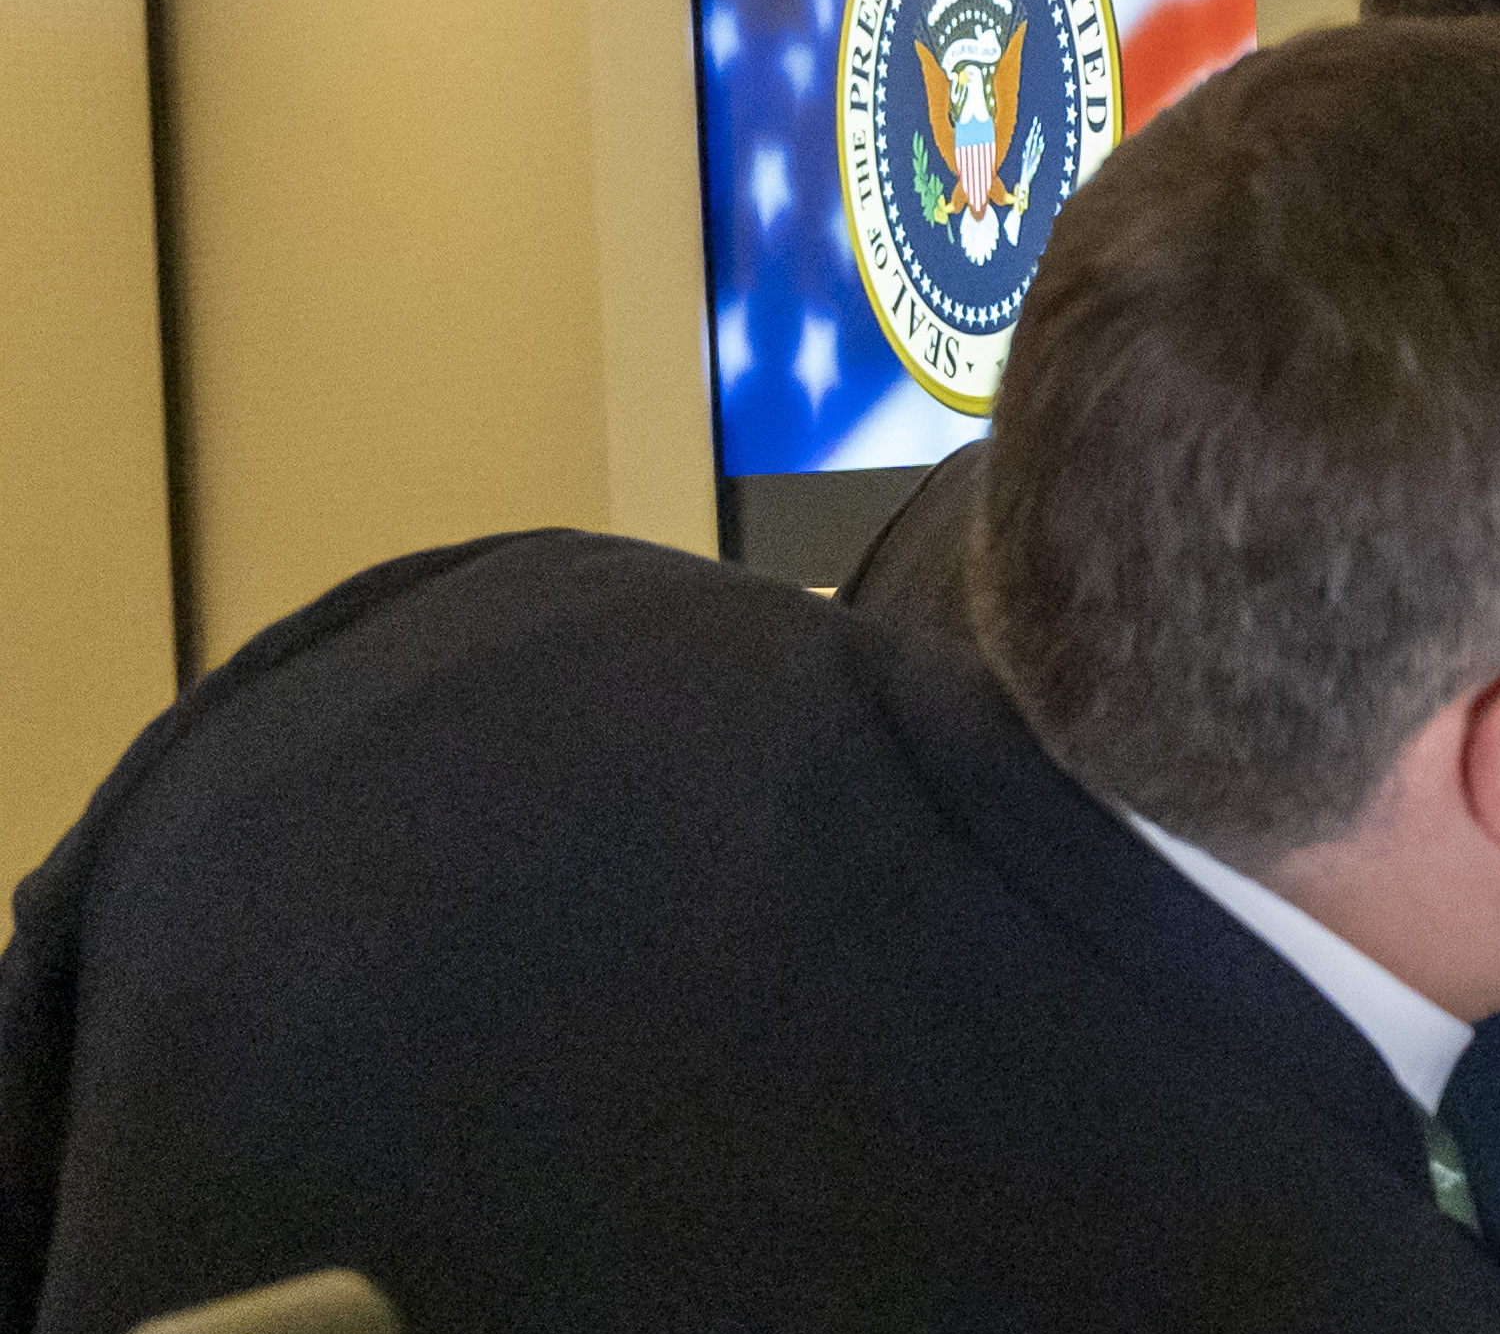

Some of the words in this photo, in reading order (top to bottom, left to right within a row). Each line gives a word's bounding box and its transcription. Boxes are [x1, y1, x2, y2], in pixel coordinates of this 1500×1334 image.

[852, 129, 873, 211] THE
[867, 227, 888, 270] OF
[891, 269, 960, 379] SEAL
